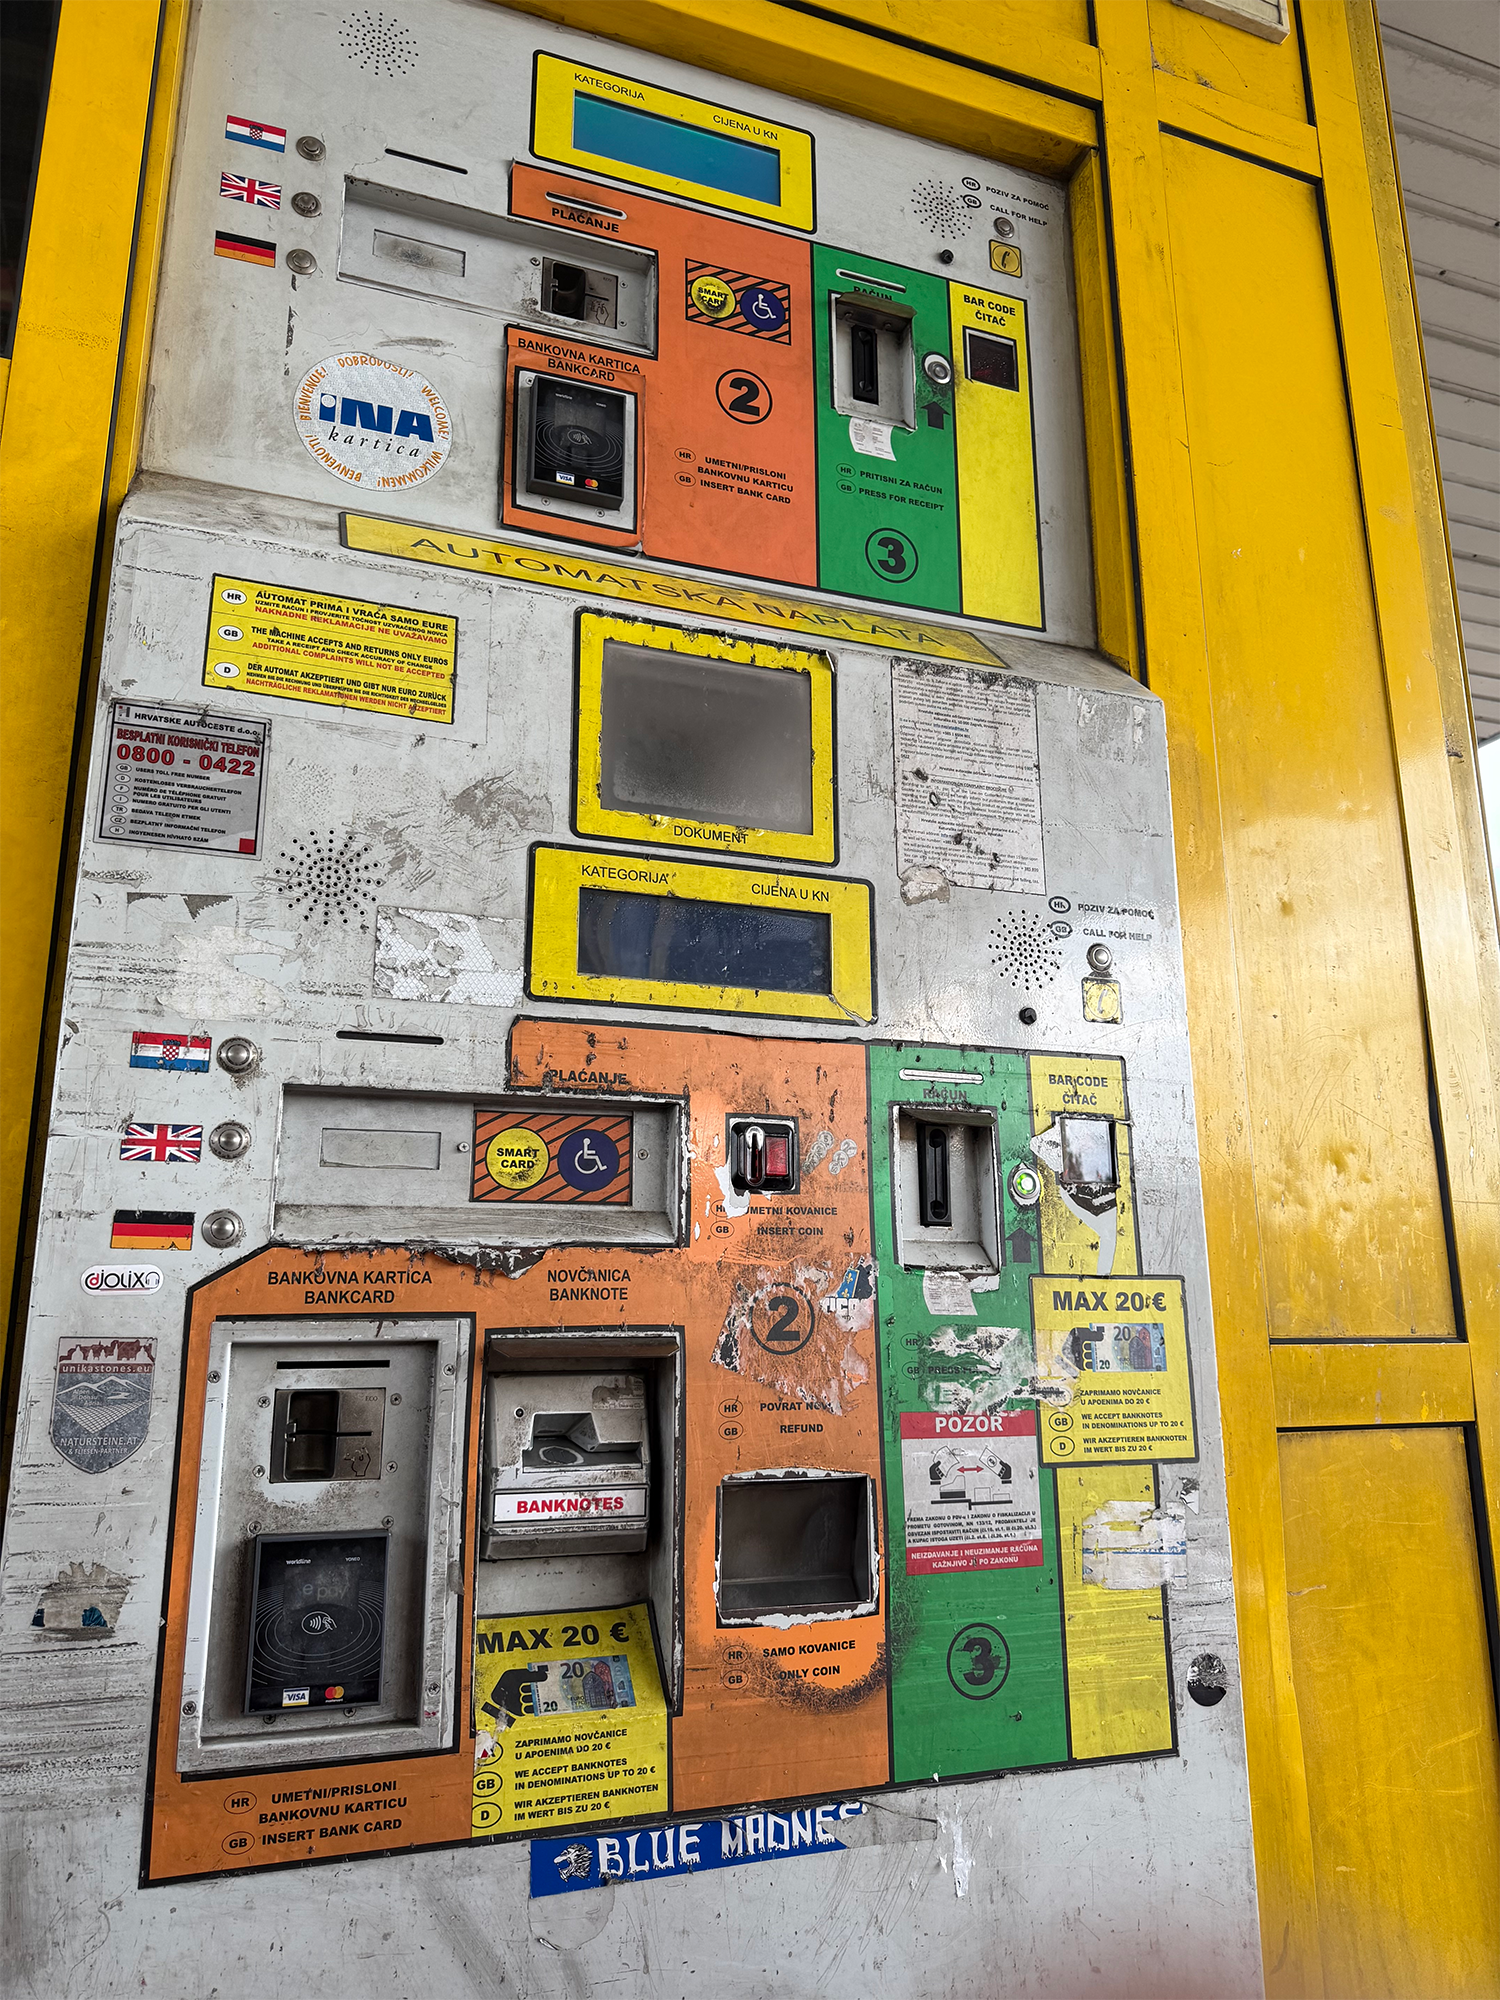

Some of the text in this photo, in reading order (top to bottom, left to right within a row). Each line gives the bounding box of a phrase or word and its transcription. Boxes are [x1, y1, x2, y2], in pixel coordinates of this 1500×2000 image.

[575, 73, 645, 101] KATEGORIJA
[713, 115, 777, 140] CIJENA U KN
[552, 207, 619, 233] PLAĆANJE
[990, 204, 1047, 226] CALL FOR HELP
[698, 286, 729, 301] SMART
[964, 295, 1016, 316] BAR CODE
[976, 310, 1006, 326] ČITAČ
[518, 338, 640, 374] BANKOVNA KARTICA
[548, 358, 615, 381] BANKCARD
[298, 366, 329, 420] BIENVENUE!
[729, 377, 760, 417] 2
[421, 385, 450, 440] WELCOME!
[328, 426, 419, 457] kartica
[305, 434, 362, 482] BENVENUTI!
[704, 456, 786, 480] UMETNI/PRISLONI
[698, 466, 793, 492] BANKOVNU KARTICU
[860, 470, 942, 494] PRITISNI ZA RAČUN
[700, 480, 791, 504] INSERT BANK CARD
[859, 488, 944, 511] PRESS FOR RECEIPT
[877, 537, 906, 574] 3
[409, 538, 946, 647] AUTOMATSKA NAPLATA
[255, 590, 307, 606] AUTOMAT
[310, 600, 343, 614] PRIMA
[352, 607, 387, 620] VRAĆA
[390, 614, 419, 626] SAMO
[422, 620, 448, 631] EURE
[255, 606, 448, 645] NAKNADNE REKLAMACIJE NE UVAŽAVAMO
[251, 626, 448, 666] THE MACHINE ACCEPTS AND RETURNS ONLY EUROS
[252, 642, 445, 680] ADDITIONAL COMPLAINTS WILL NOT BE ACCEPTED
[248, 662, 446, 702] DER AUTOMAT AKZEPTIERT UND GIBT NUR EURO ZURÜCK
[135, 712, 181, 725] HRVATSKE
[184, 718, 235, 732] AUTOCESTE
[117, 728, 260, 757] BESPLATNI KORISNIČKI TELEFON
[117, 744, 175, 765] 0800
[200, 755, 256, 776] 0422
[186, 773, 210, 781] NUMBER
[673, 825, 748, 844] DOKUMENT
[581, 864, 669, 884] KATEGORIJA
[751, 883, 829, 902] CIJENA U KN
[550, 1068, 627, 1085] PLAĆANJE
[1049, 1074, 1108, 1087] BAR CODE
[1063, 1092, 1097, 1106] ČITAČ
[496, 1147, 540, 1158] SMART
[500, 1159, 535, 1170] CARD
[786, 1207, 837, 1215] KOVANICE
[757, 1227, 823, 1235] INSERT COIN
[267, 1270, 432, 1285] BANKOVNA KARTICA
[547, 1266, 631, 1283] NOVČANICA
[304, 1290, 395, 1304] BANKCARD
[550, 1287, 628, 1301] BANKNOTE
[1053, 1291, 1167, 1312] MAX 20 €
[766, 1296, 800, 1341] 2
[62, 1365, 150, 1373] unikastones.eu
[760, 1402, 804, 1411] POVRAT
[780, 1424, 823, 1433] REFUND
[935, 1416, 1003, 1433] POZOR
[60, 1437, 137, 1446] NATURSTEINE.AT
[516, 1496, 624, 1514] BANKNOTES
[911, 1549, 958, 1559] NEIZDAVANJE
[964, 1547, 1008, 1556] NEUZIMANJE
[1010, 1544, 1038, 1553] RAČUNA
[933, 1559, 967, 1568] KAŽNJIVO
[991, 1556, 1019, 1564] ZAKONU
[477, 1622, 629, 1655] MAX 20 €
[763, 1640, 856, 1657] SAMO KOVANICE
[962, 1637, 999, 1686] 3
[779, 1666, 840, 1680] ONLY COIN
[287, 1692, 306, 1701] VISA
[543, 1700, 558, 1712] 20
[515, 1729, 628, 1748] ZAPRIMAMO NOVČANICE
[515, 1758, 628, 1778] WE ACCEPT BANKNOTES
[231, 1781, 397, 1808] HR UMETNI/PRISLONI
[514, 1784, 659, 1809] WIR AKZEPTIEREN BANKNOTEN
[259, 1797, 407, 1824] BANKOVNU KARTICU
[229, 1819, 402, 1849] GB INSERT BANK CARD
[597, 1824, 703, 1876] BLUE
